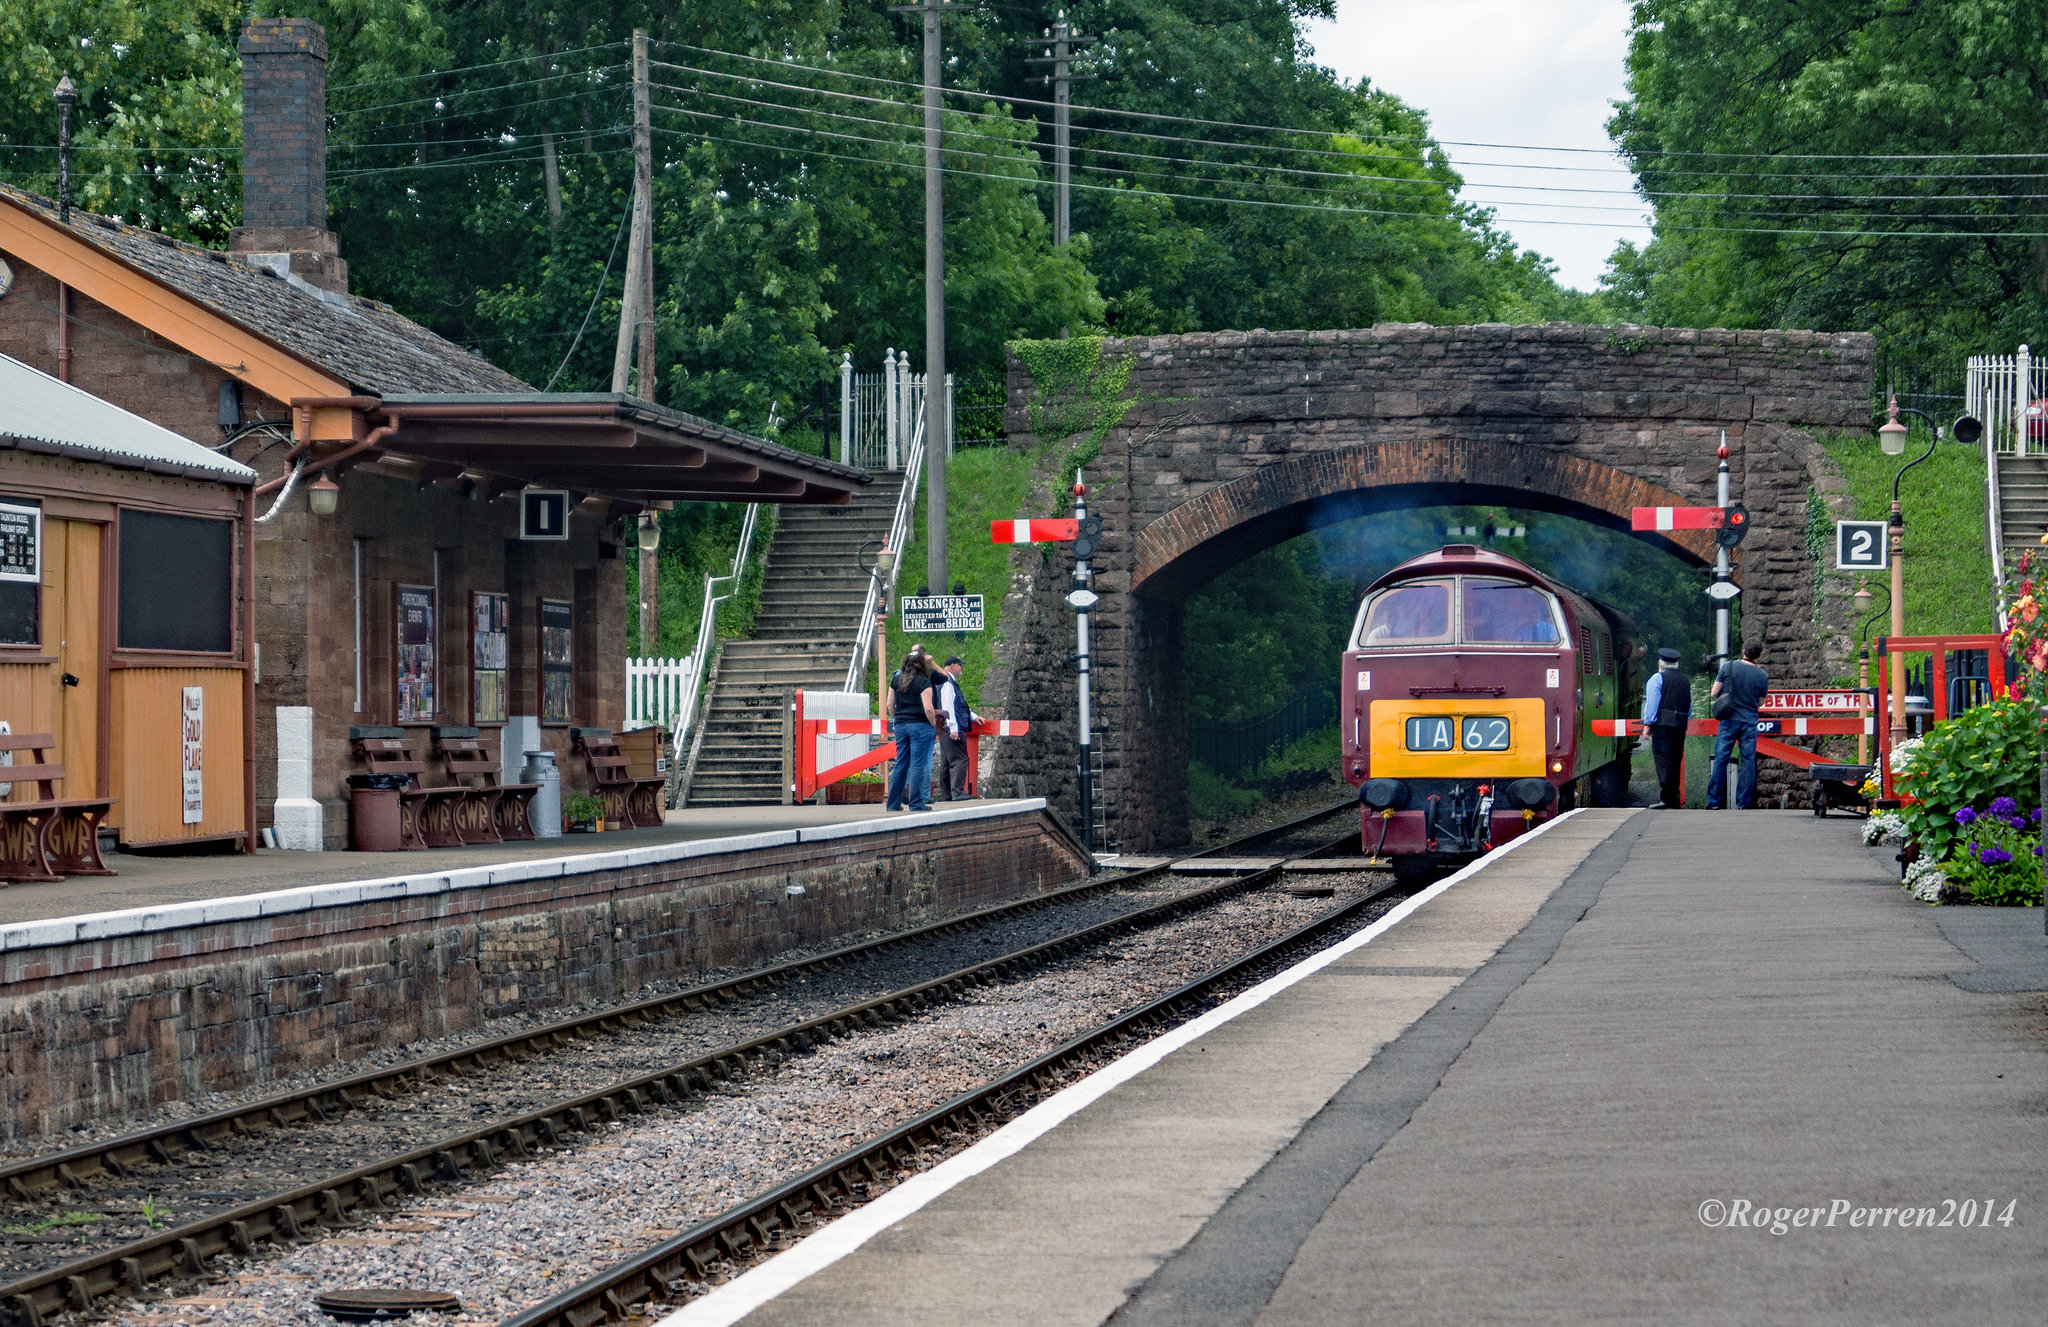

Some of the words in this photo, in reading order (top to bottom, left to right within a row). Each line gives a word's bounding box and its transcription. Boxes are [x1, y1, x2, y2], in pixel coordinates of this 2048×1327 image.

[540, 500, 549, 529] 1
[1851, 530, 1872, 560] 2
[402, 593, 428, 607] FORTHCOMING
[905, 598, 968, 609] PASSENGERS
[408, 610, 423, 622] EVENTS
[906, 619, 927, 628] LINE
[946, 618, 981, 628] BRIDGE
[942, 608, 970, 618] CROSS
[1764, 694, 1824, 708] BEWARE
[1827, 696, 1840, 706] OF
[417, 801, 450, 833] GWR
[456, 800, 489, 830] GWR
[494, 799, 524, 828] GWR
[47, 816, 90, 857] GWR
